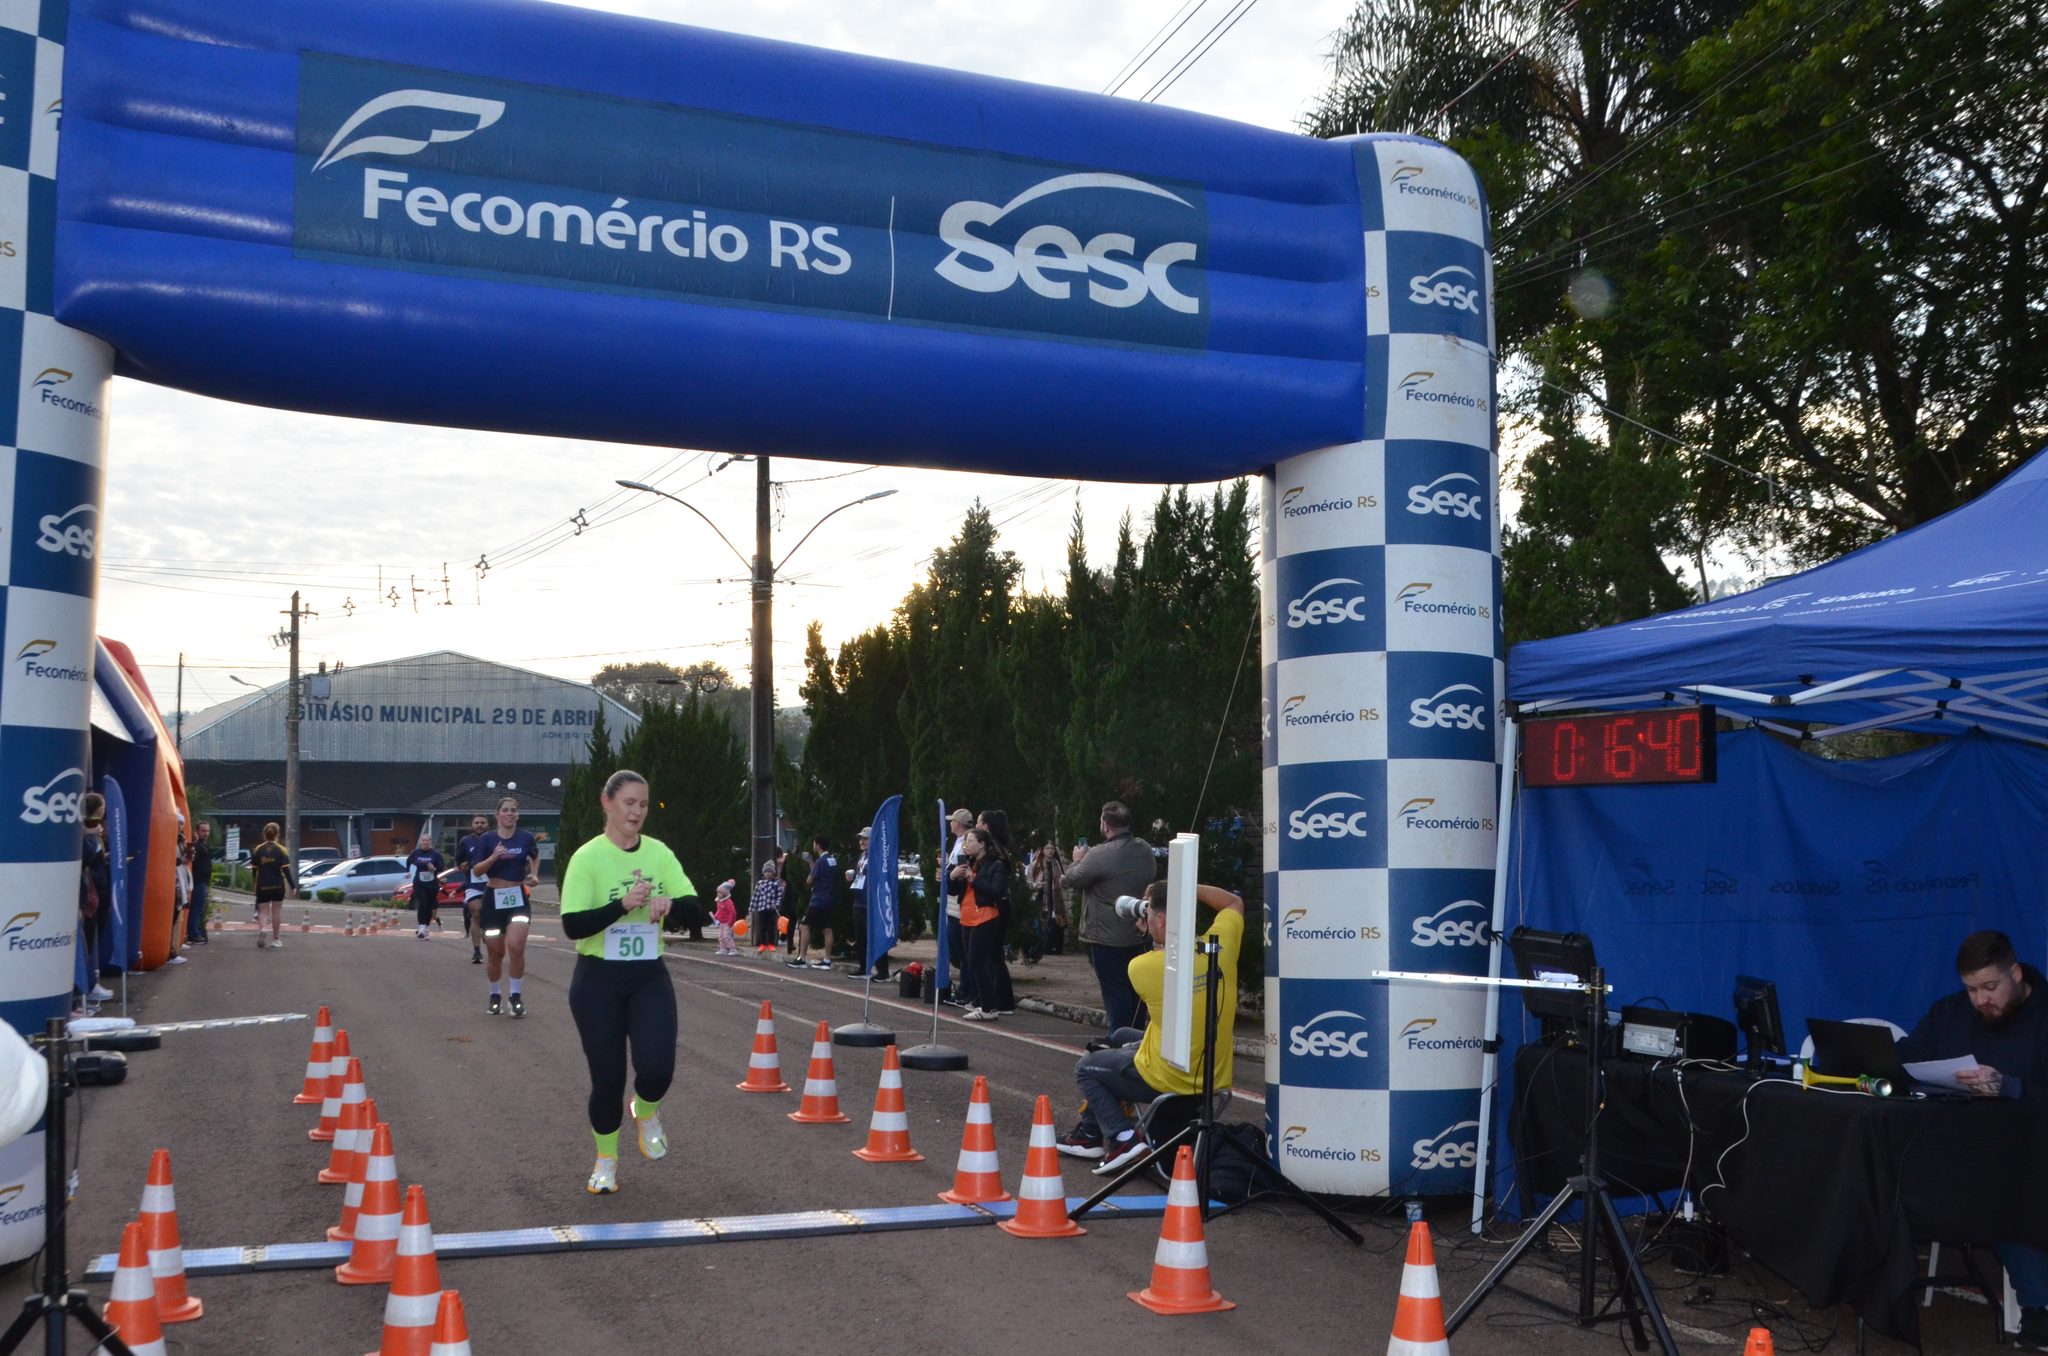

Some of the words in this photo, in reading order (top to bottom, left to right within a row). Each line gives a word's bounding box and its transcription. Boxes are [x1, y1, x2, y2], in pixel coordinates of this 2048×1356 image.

[1399, 183, 1466, 204] Fecomércio
[363, 167, 749, 262] Fecomércio
[770, 220, 852, 275] RS
[934, 172, 1199, 315] Sesc
[1408, 265, 1479, 315] Sesc
[1406, 389, 1475, 408] Fecomércio
[1476, 398, 1488, 412] RS
[1284, 498, 1353, 519] Fecomércio
[1357, 495, 1377, 508] RS
[1406, 472, 1481, 520] Sesc
[36, 504, 97, 559] Ses
[1287, 578, 1366, 628] Sesc
[1404, 600, 1477, 617] Fecomércio
[1478, 606, 1490, 619] RS
[380, 705, 485, 724] MUNICIPAL
[493, 708, 517, 724] 29
[522, 708, 546, 725] DE
[1285, 710, 1354, 726] Fecomércio
[1359, 708, 1380, 720] RS
[1408, 683, 1486, 731] Sesc
[1288, 792, 1367, 840] Sesc
[1407, 816, 1480, 830] Fecomércio
[1481, 818, 1494, 831] RS
[502, 895, 516, 906] 49
[1286, 926, 1356, 940] Fecomércio
[1360, 926, 1381, 939] RS
[1411, 899, 1489, 947] Sesc
[619, 936, 644, 957] 50
[1289, 1010, 1369, 1058] Sesc
[1408, 1036, 1482, 1050] Fecomércio
[1286, 1143, 1356, 1162] Fecomércio
[1360, 1148, 1381, 1162] RS
